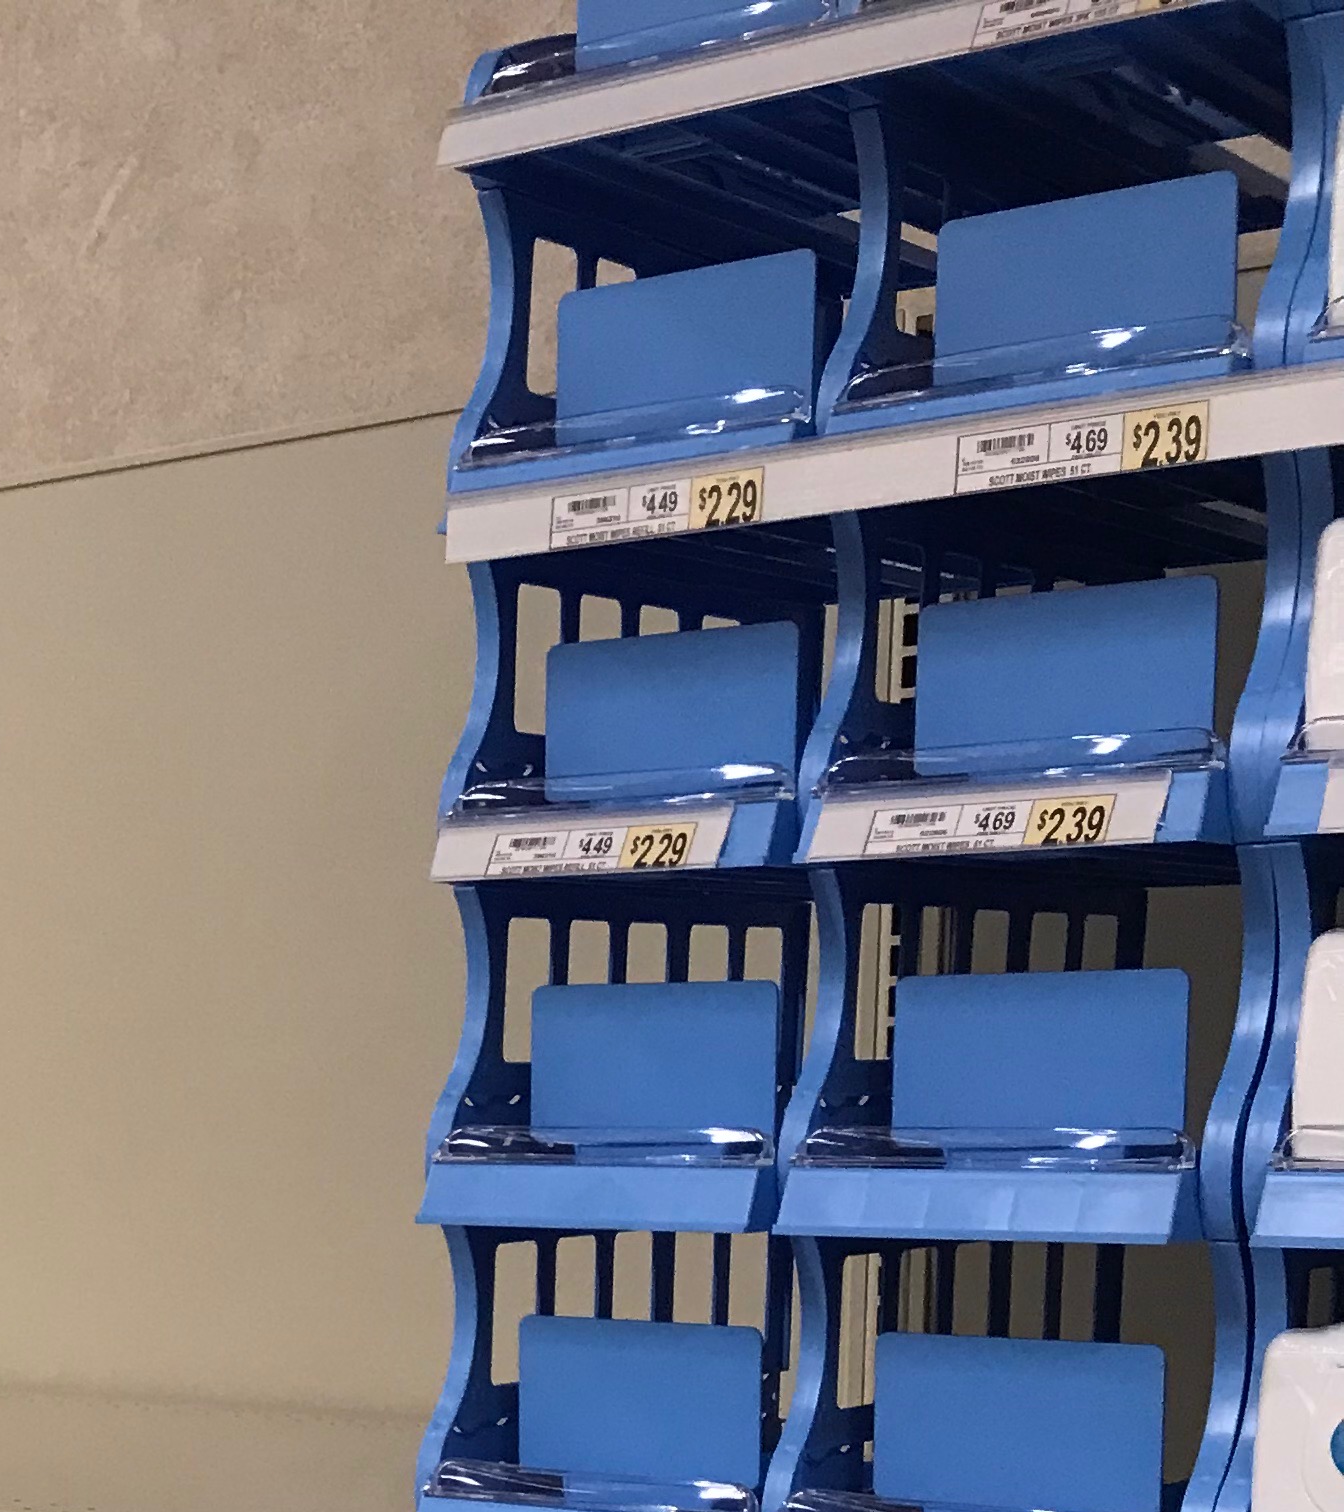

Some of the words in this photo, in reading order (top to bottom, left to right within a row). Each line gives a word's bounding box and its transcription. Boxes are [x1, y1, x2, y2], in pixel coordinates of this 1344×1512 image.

[1133, 415, 1202, 467] $2.39
[989, 473, 1014, 487] SCOTT
[1081, 463, 1092, 474] CT
[699, 480, 757, 527] $2.29
[1038, 805, 1105, 846] $2.39
[630, 833, 688, 868] $2.29
